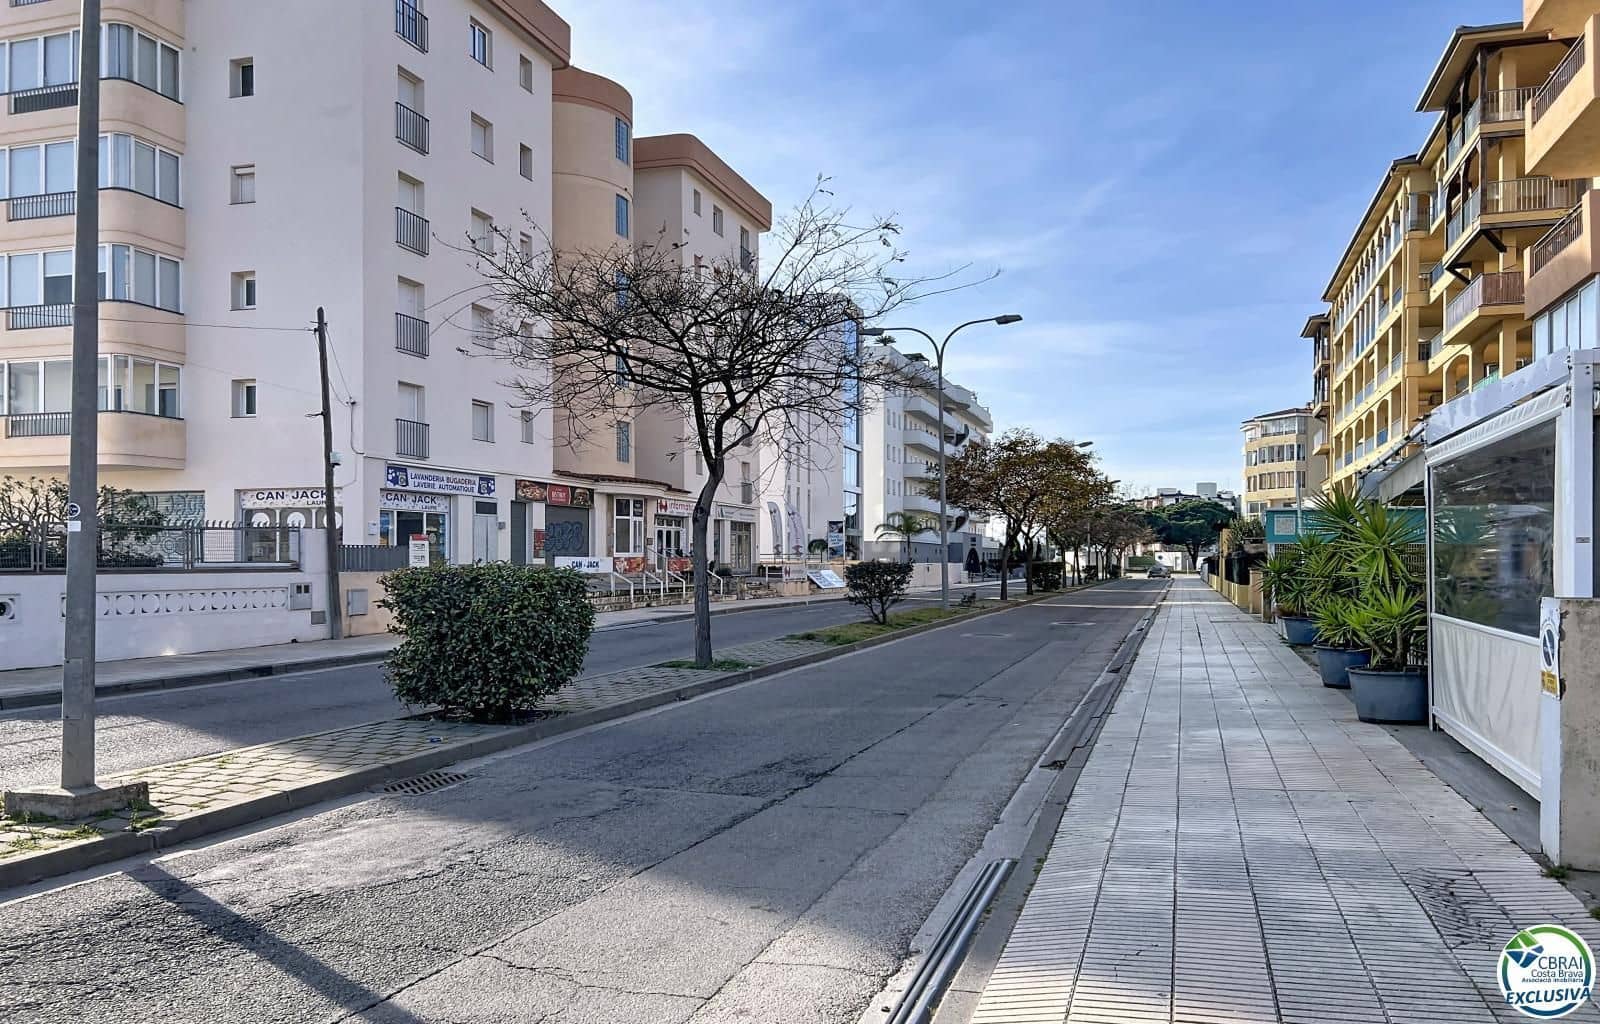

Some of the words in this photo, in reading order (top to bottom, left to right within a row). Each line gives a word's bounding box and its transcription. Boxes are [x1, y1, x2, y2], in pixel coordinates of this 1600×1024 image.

[410, 473, 445, 482] LAVANDERIA
[438, 484, 475, 493] AUTOMATIQUE
[255, 491, 285, 501] CAN
[385, 492, 407, 502] CAN
[411, 495, 437, 505] JACK
[587, 560, 600, 569] JACK
